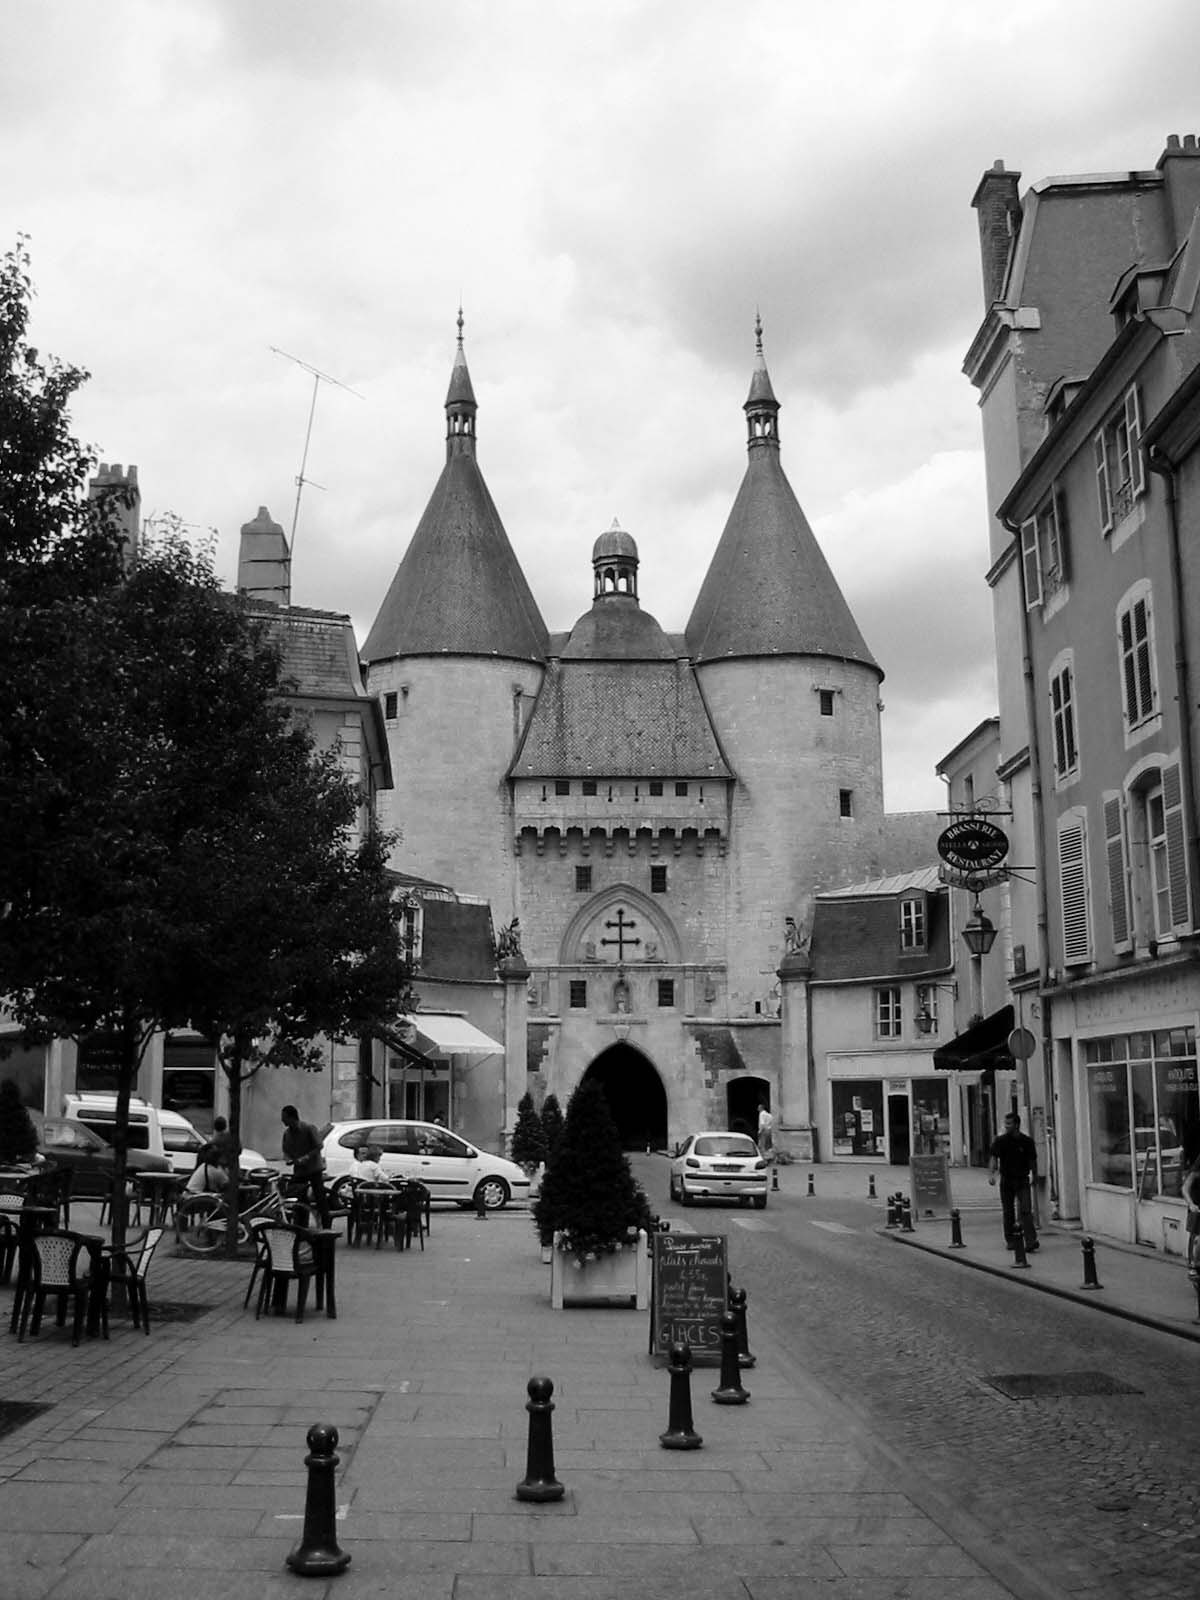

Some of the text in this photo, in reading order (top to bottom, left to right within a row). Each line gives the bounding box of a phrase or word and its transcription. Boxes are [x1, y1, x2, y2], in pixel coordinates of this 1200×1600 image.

[946, 823, 997, 839] BRASSERIE
[947, 849, 1003, 868] RESTAURANT
[660, 1324, 720, 1345] GLACES
